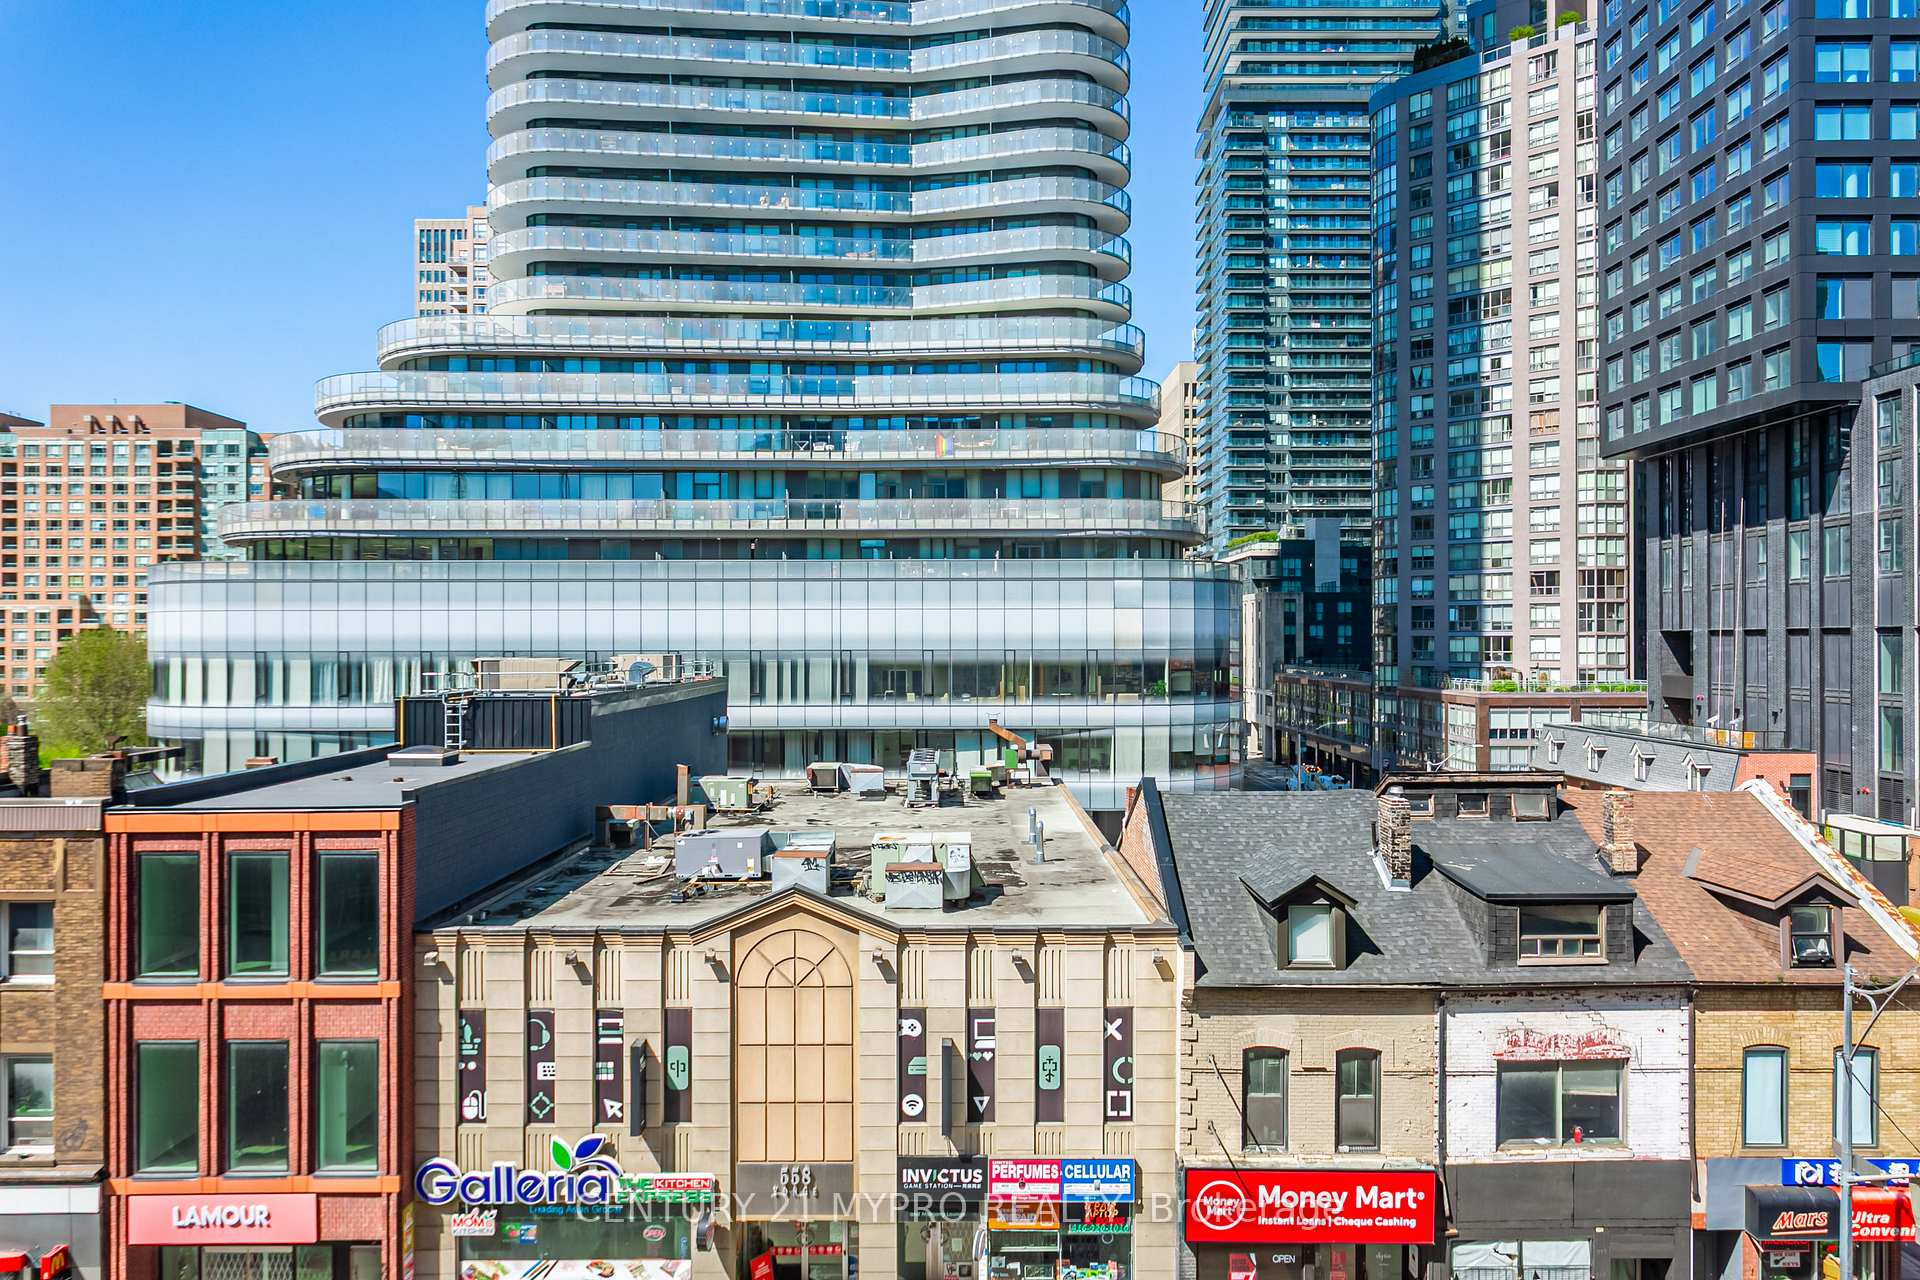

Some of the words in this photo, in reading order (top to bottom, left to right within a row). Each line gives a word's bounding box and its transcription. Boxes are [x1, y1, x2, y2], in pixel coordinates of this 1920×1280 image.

[902, 1168, 983, 1183] INVICTUS
[991, 1164, 1059, 1179] PERFUMES
[1064, 1164, 1131, 1179] CELLULAR
[414, 1157, 612, 1205] Galleria
[617, 1177, 653, 1190] THE
[656, 1179, 710, 1188] KITCHEN
[616, 1190, 712, 1204] EXPRESS
[1203, 1195, 1240, 1208] Money
[1257, 1184, 1348, 1213] Money
[172, 1204, 271, 1229] LAMOUR
[1257, 1216, 1294, 1225] Instant
[1297, 1216, 1326, 1225] Loans
[1334, 1216, 1373, 1227] Cheque
[1375, 1216, 1417, 1228] Cashing
[1772, 1210, 1829, 1231] Mars
[1272, 1254, 1296, 1264] OPEN
